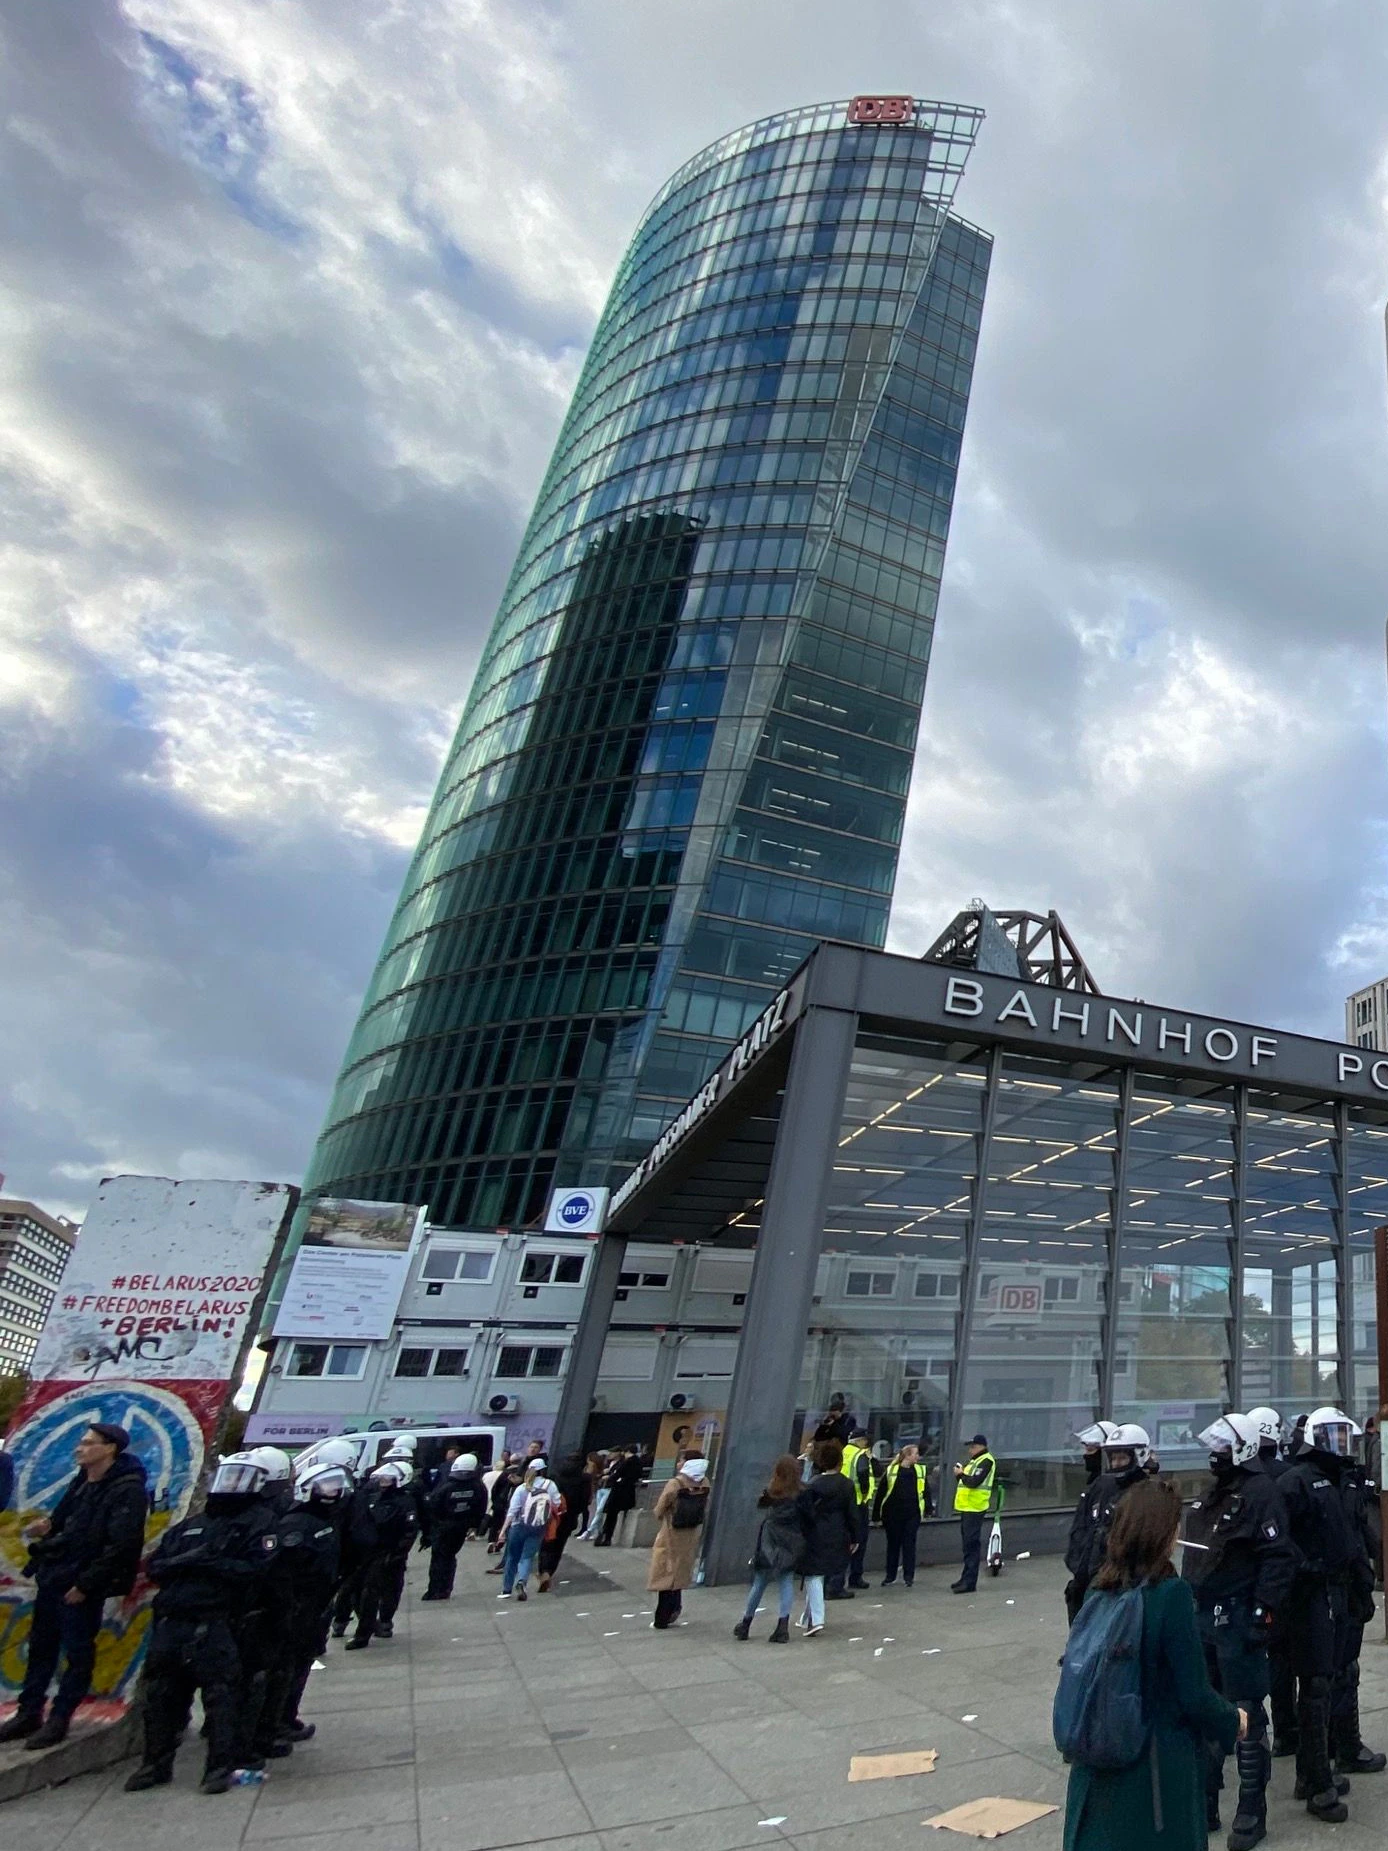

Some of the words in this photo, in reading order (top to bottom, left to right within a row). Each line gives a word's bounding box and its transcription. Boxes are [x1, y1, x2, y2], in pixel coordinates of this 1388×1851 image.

[944, 976, 1279, 1066] BAHNHOF
[727, 989, 790, 1081] PLATZ
[564, 1205, 588, 1216] BVE
[111, 1274, 263, 1293] #BELARUS2020
[62, 1295, 251, 1316] #FREEDOMBELARUS
[1005, 1290, 1036, 1309] DB
[263, 1427, 287, 1435] FOR
[288, 1427, 330, 1435] BERLIN
[1259, 1423, 1272, 1435] 23
[1246, 1442, 1258, 1458] 23
